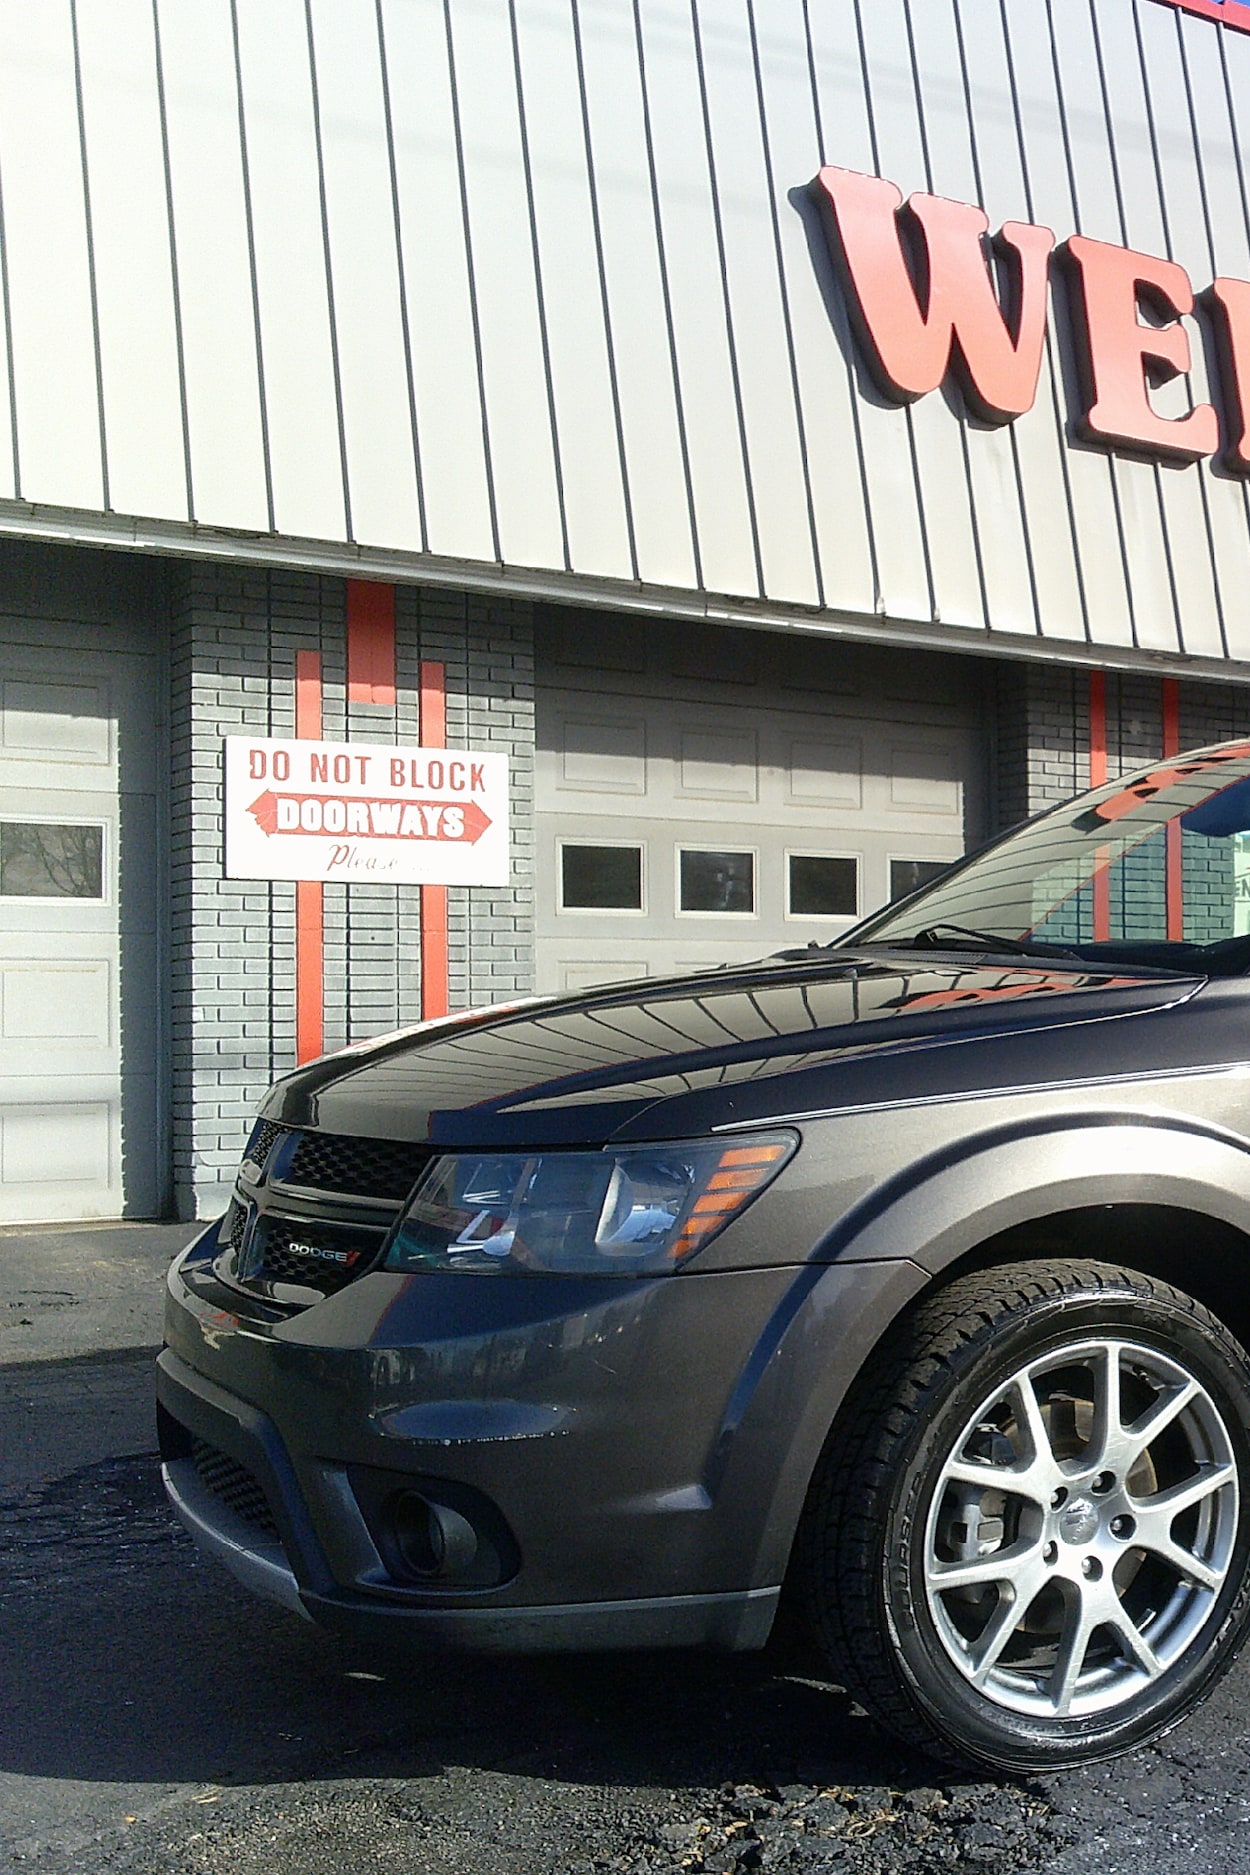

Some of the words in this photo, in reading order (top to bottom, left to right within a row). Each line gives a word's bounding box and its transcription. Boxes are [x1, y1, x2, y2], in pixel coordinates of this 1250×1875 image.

[249, 749, 290, 781] DO
[310, 753, 372, 785] NOT
[390, 758, 486, 792] BLOCK
[277, 798, 465, 838] DOORWAYS
[289, 1243, 348, 1262] DODGE
